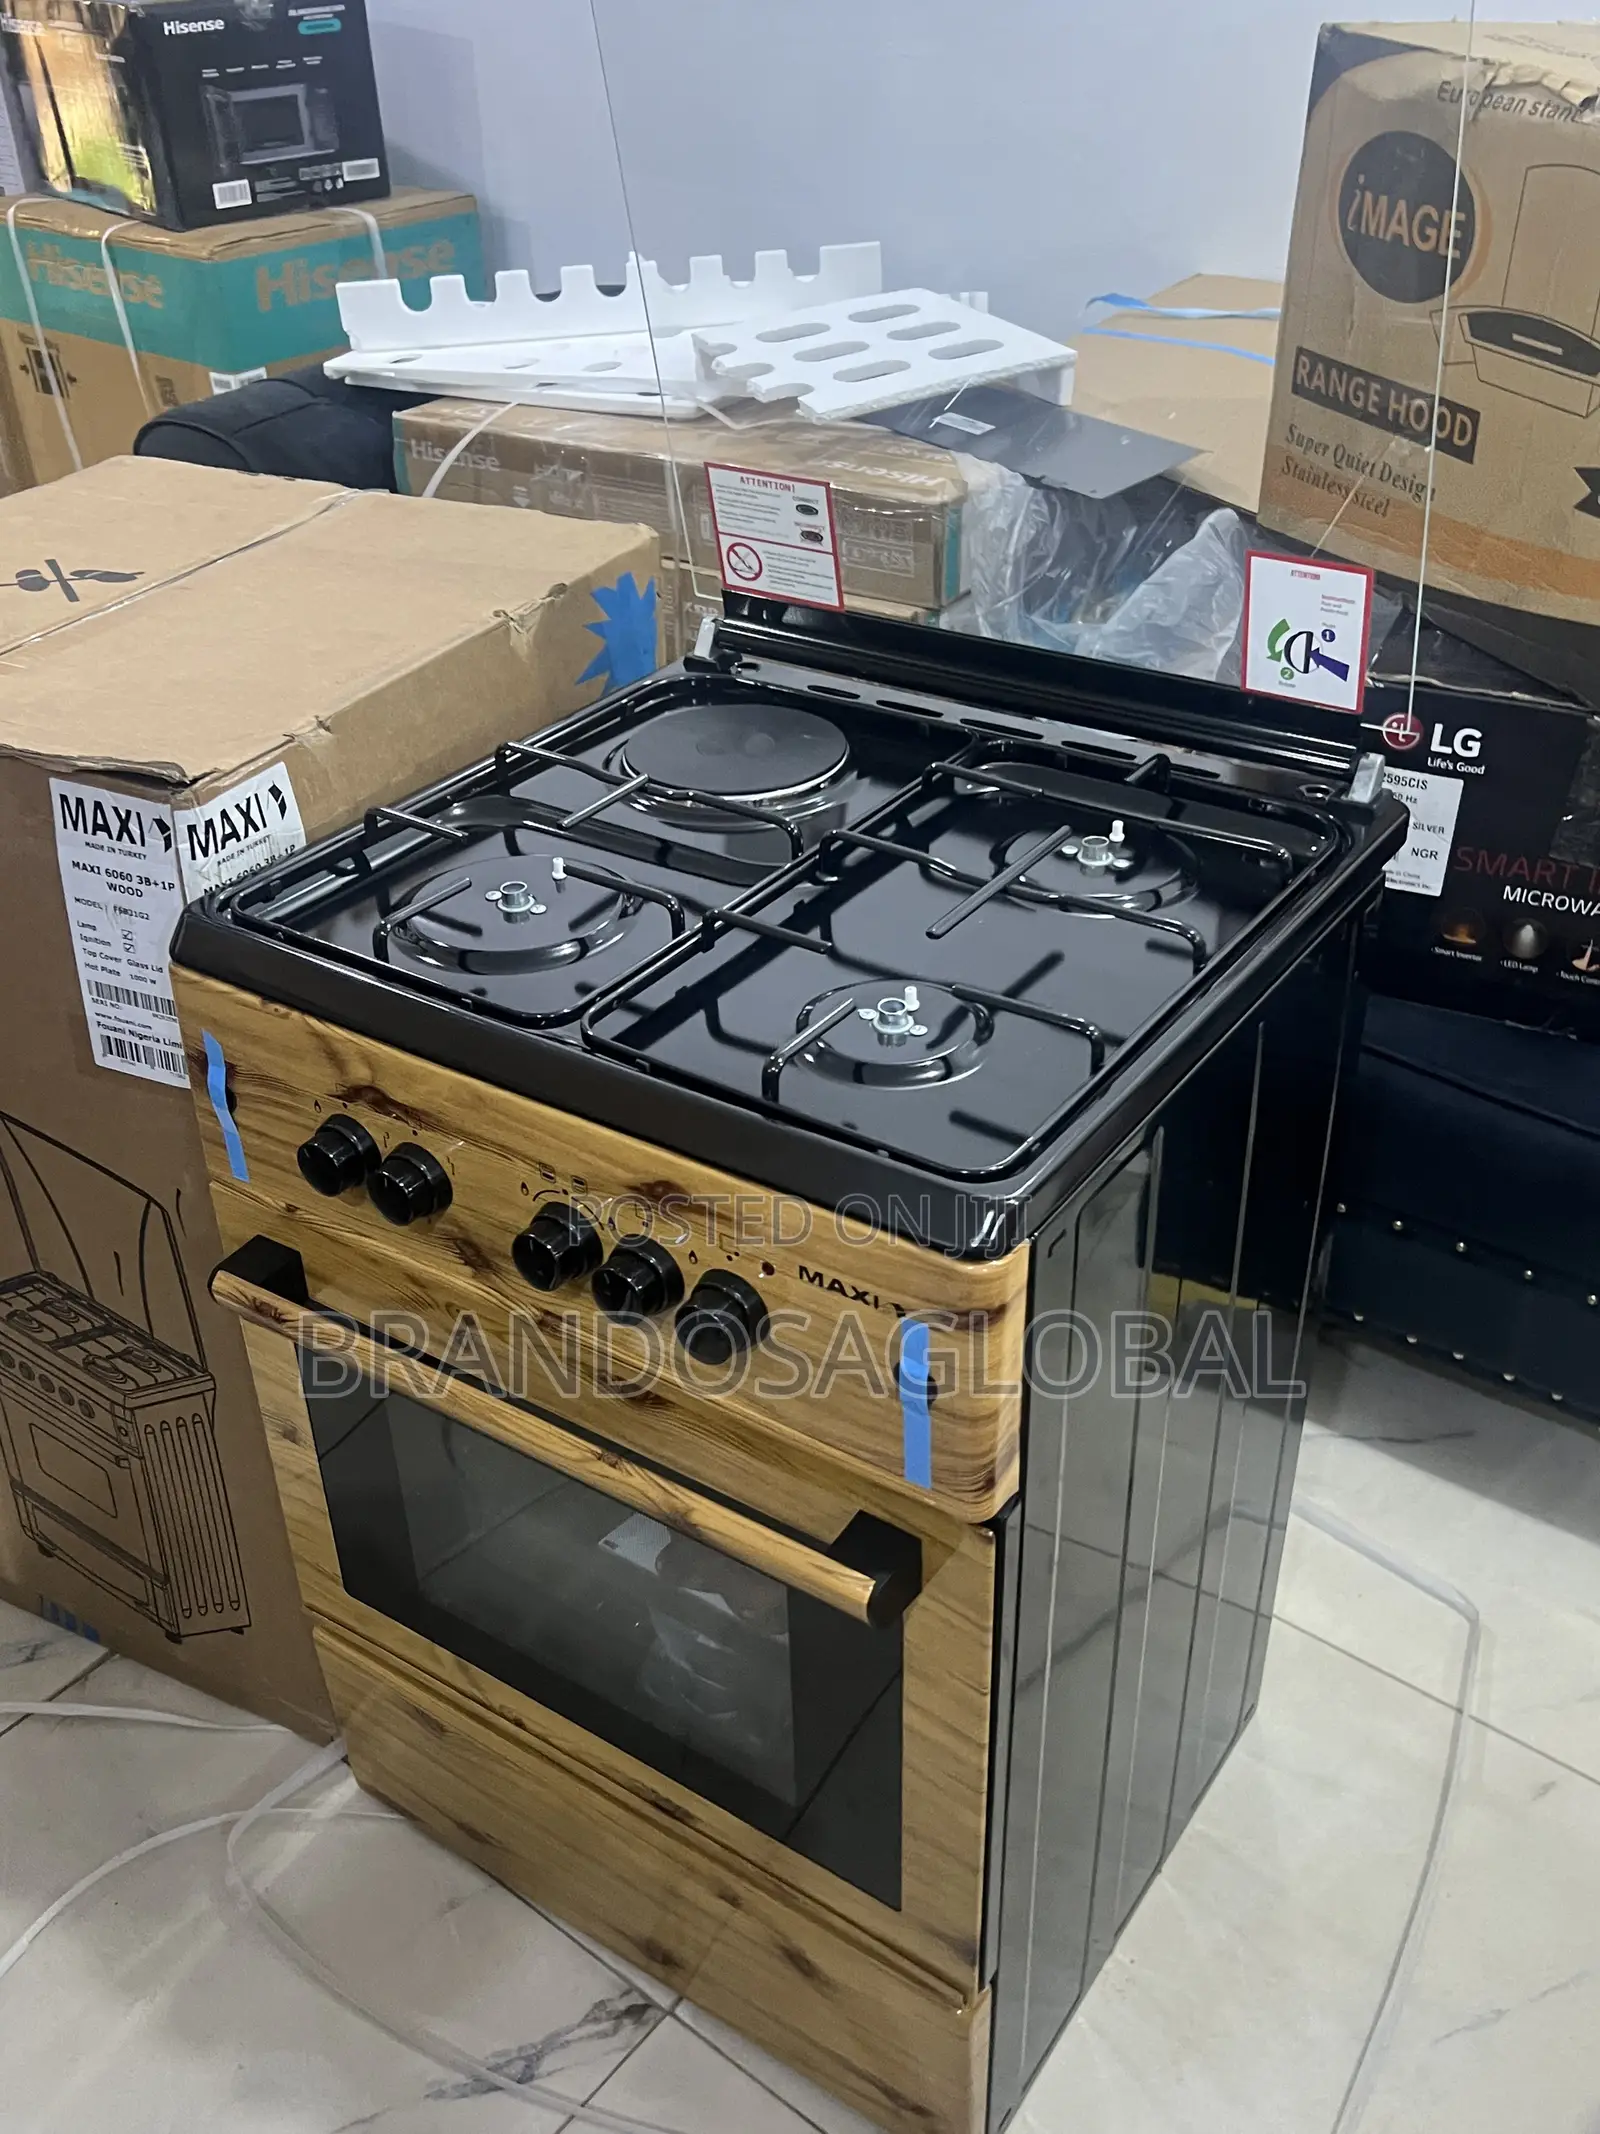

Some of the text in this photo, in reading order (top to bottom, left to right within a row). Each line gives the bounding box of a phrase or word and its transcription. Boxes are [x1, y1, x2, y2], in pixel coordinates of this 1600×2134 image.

[163, 18, 225, 35] Hisense
[28, 240, 164, 309] Hisense
[1296, 355, 1472, 447] RANGE HOOD
[1285, 423, 1330, 459] Super
[1333, 443, 1375, 476] Quiet
[1430, 723, 1482, 758] LG
[1427, 756, 1485, 775] Life's Good
[59, 793, 145, 848] MAXI
[187, 793, 267, 861] MAXI
[1412, 821, 1445, 835] SILVER
[85, 841, 147, 861] MADE IN TURKEY
[1411, 847, 1438, 861] NGR
[72, 860, 175, 892] MAXI 6060 3B+1P
[1454, 846, 1578, 890] SMART
[106, 881, 144, 898] WOOD
[77, 920, 97, 931] Lamp
[80, 933, 112, 947] Ignition
[82, 947, 164, 974] Top Cover Glass Lid
[84, 961, 99, 972] Hot
[101, 965, 121, 977] Plate
[130, 973, 148, 984] 1000
[1504, 960, 1538, 974] LED Lamp
[96, 1020, 127, 1035] Fouani
[128, 1028, 161, 1044] Nigeria
[799, 1265, 880, 1310] MAXI
